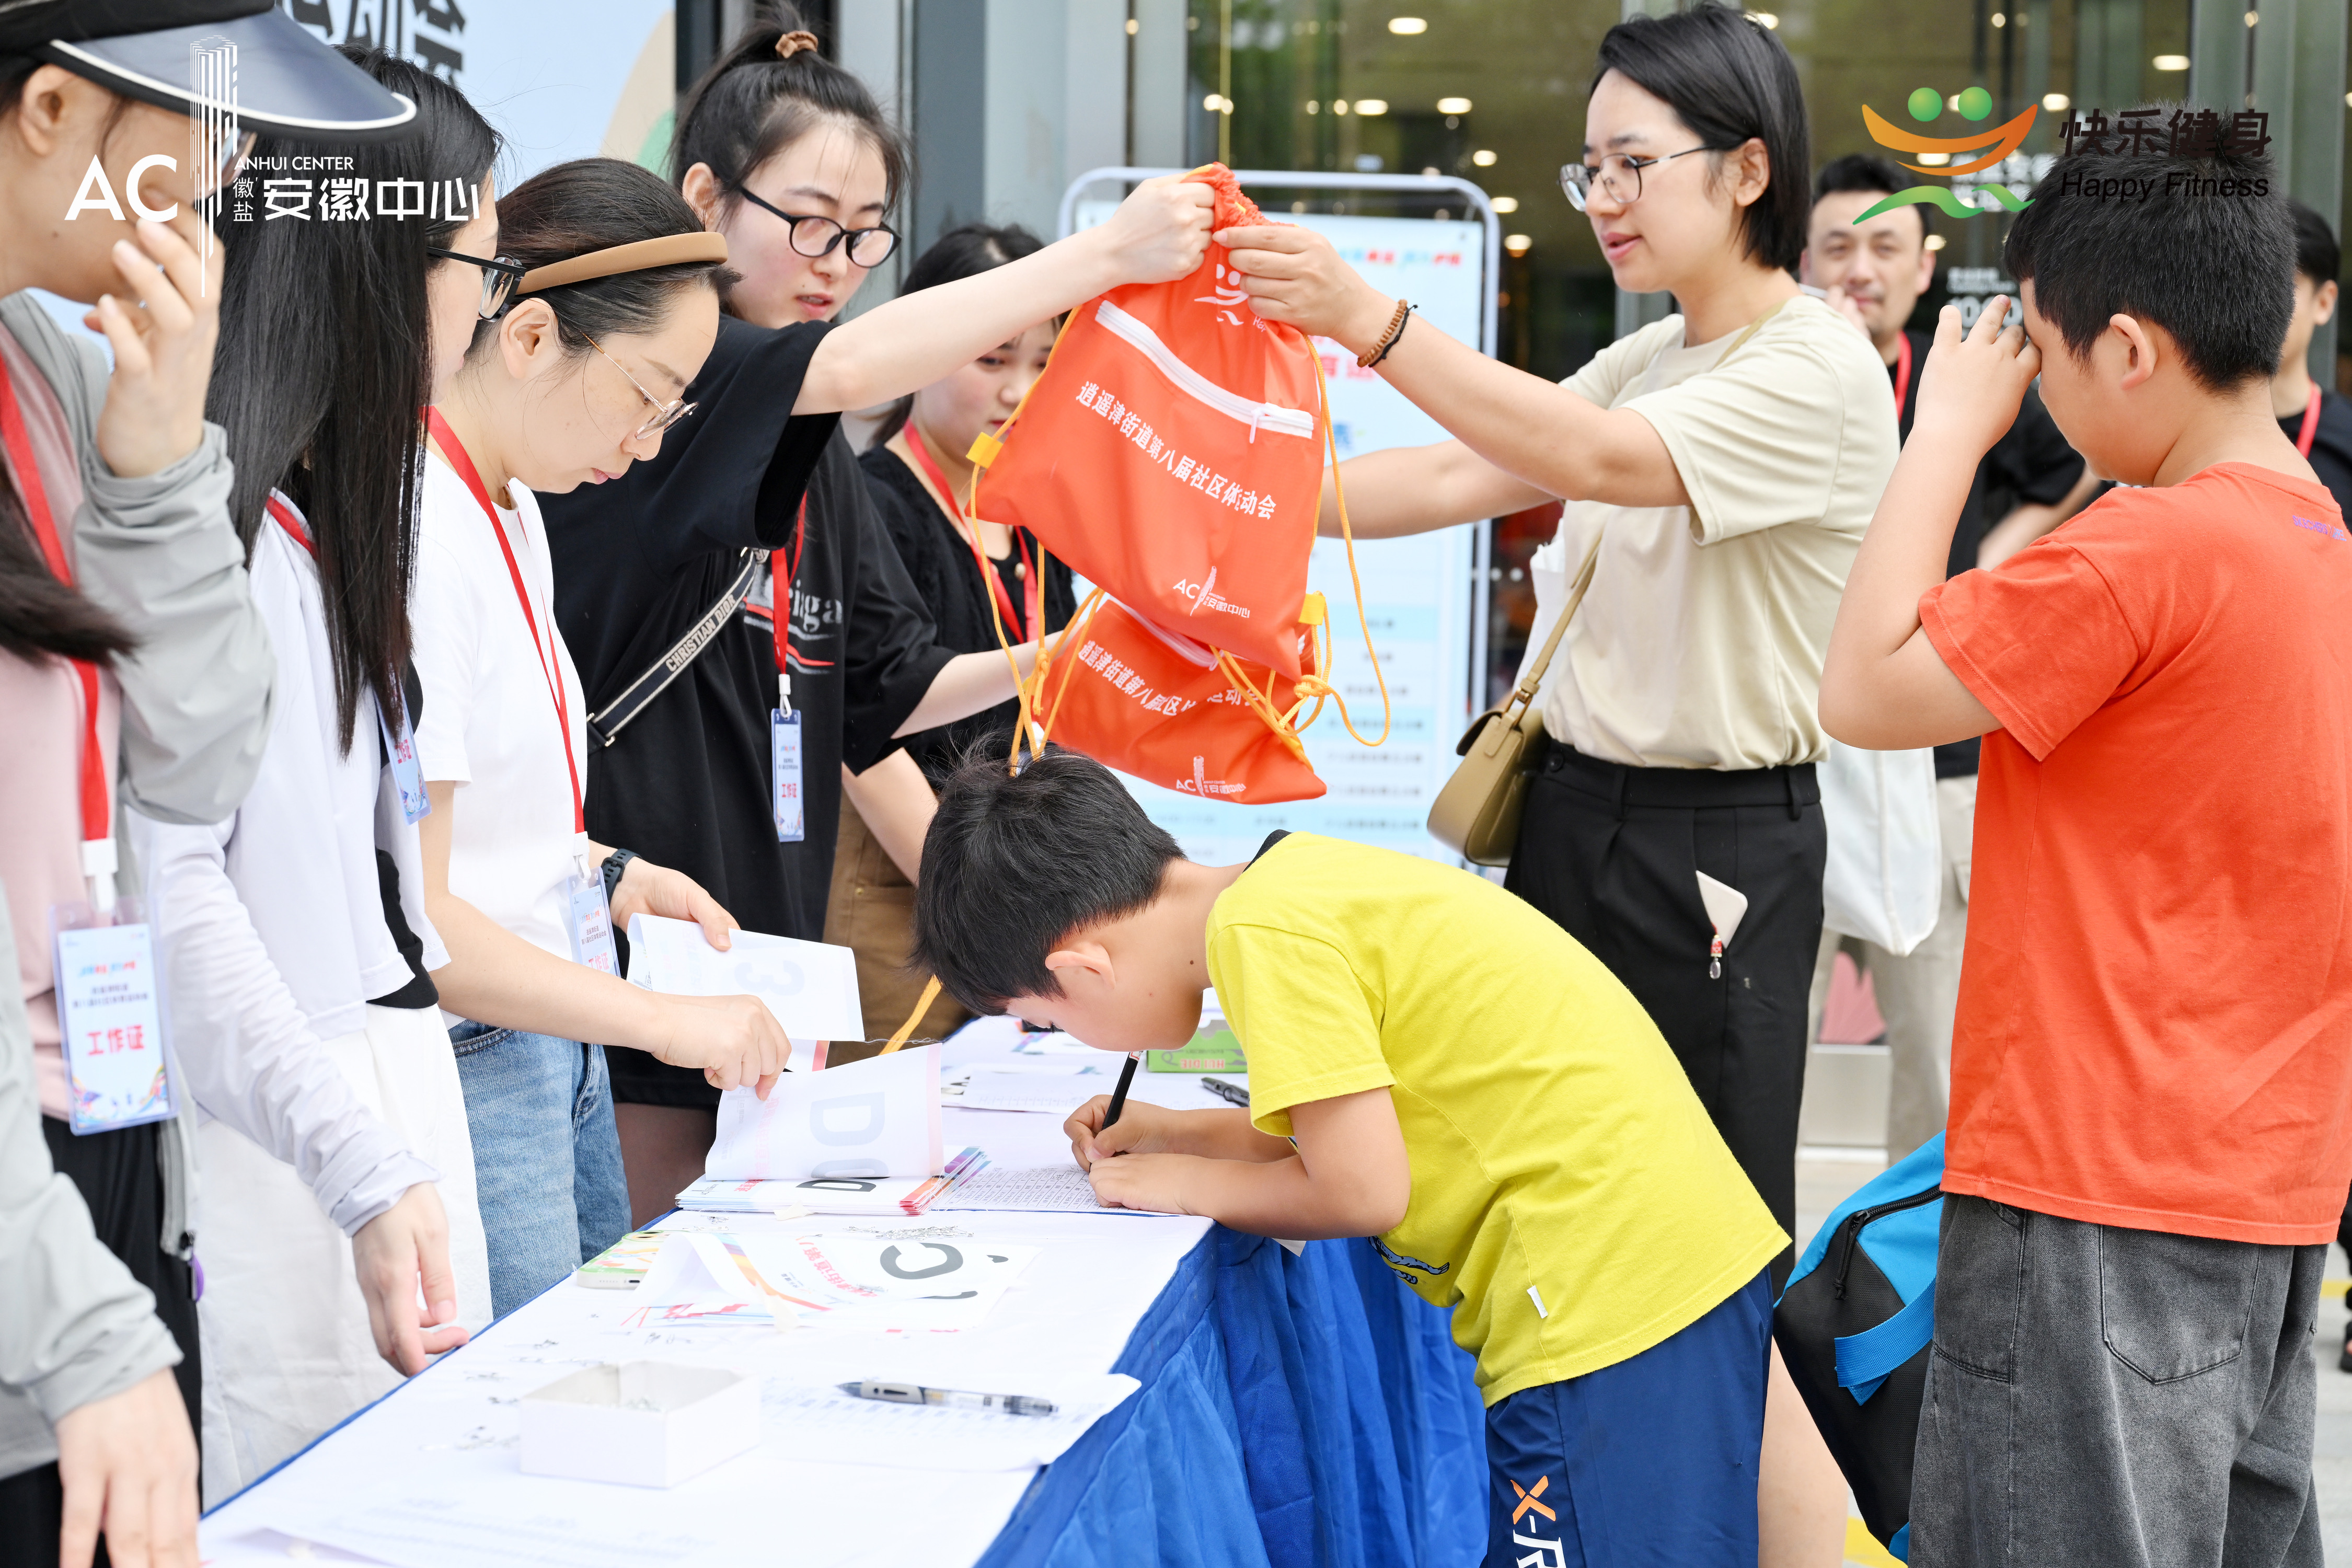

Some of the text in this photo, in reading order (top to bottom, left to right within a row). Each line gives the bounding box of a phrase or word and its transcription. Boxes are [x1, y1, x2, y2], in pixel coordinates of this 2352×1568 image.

[1172, 578, 1201, 599] AC
[1207, 597, 1250, 618] 安徽中心
[665, 593, 737, 672] CHRISTIAN DIOR
[1176, 778, 1196, 792] AC
[87, 1024, 145, 1056] 工作证
